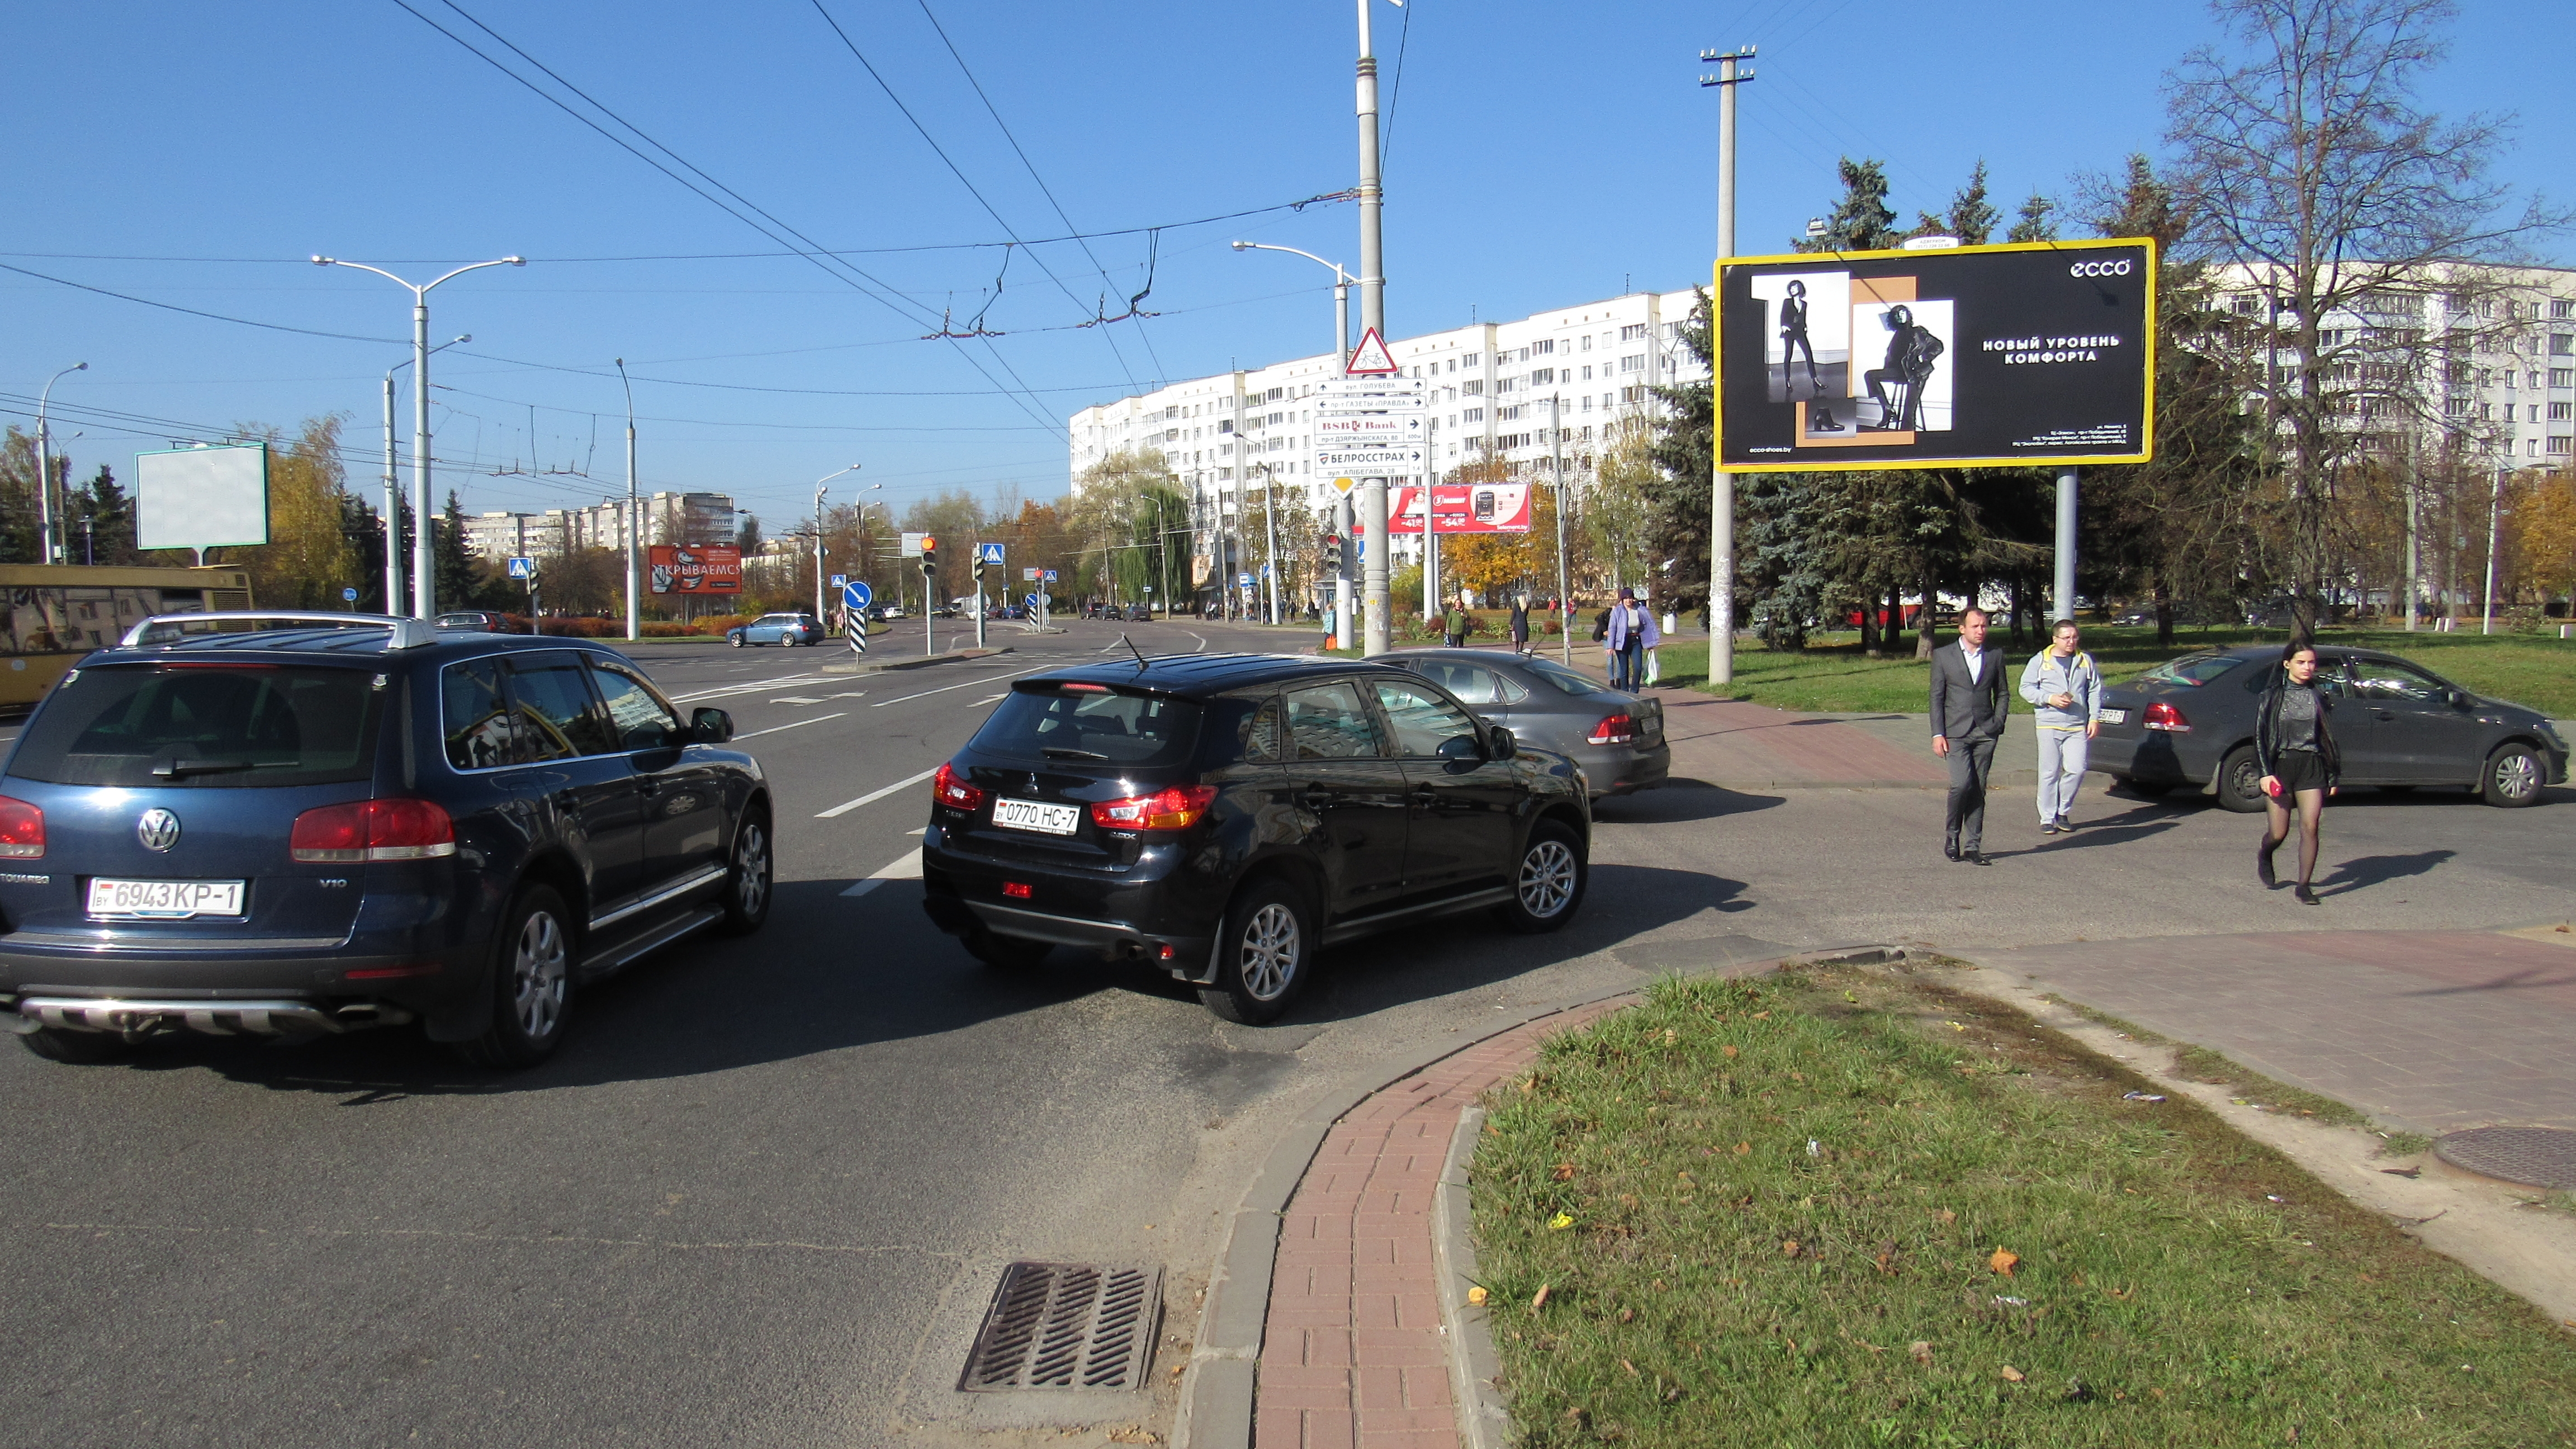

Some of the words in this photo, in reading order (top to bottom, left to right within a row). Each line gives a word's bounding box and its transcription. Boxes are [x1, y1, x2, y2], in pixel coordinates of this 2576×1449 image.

[2070, 259, 2130, 277] ecco
[1983, 337, 2040, 351] НОВЫЙ
[2046, 336, 2120, 349] УРОВЕНЬ
[2004, 351, 2096, 364] КОМФОРТА
[1365, 421, 1397, 429] Bank
[1331, 452, 1405, 463] БЕЛРОССТРАХ
[996, 811, 1003, 820] BY
[1007, 803, 1037, 823] 0770
[319, 879, 348, 888] V10
[96, 897, 107, 906] BY
